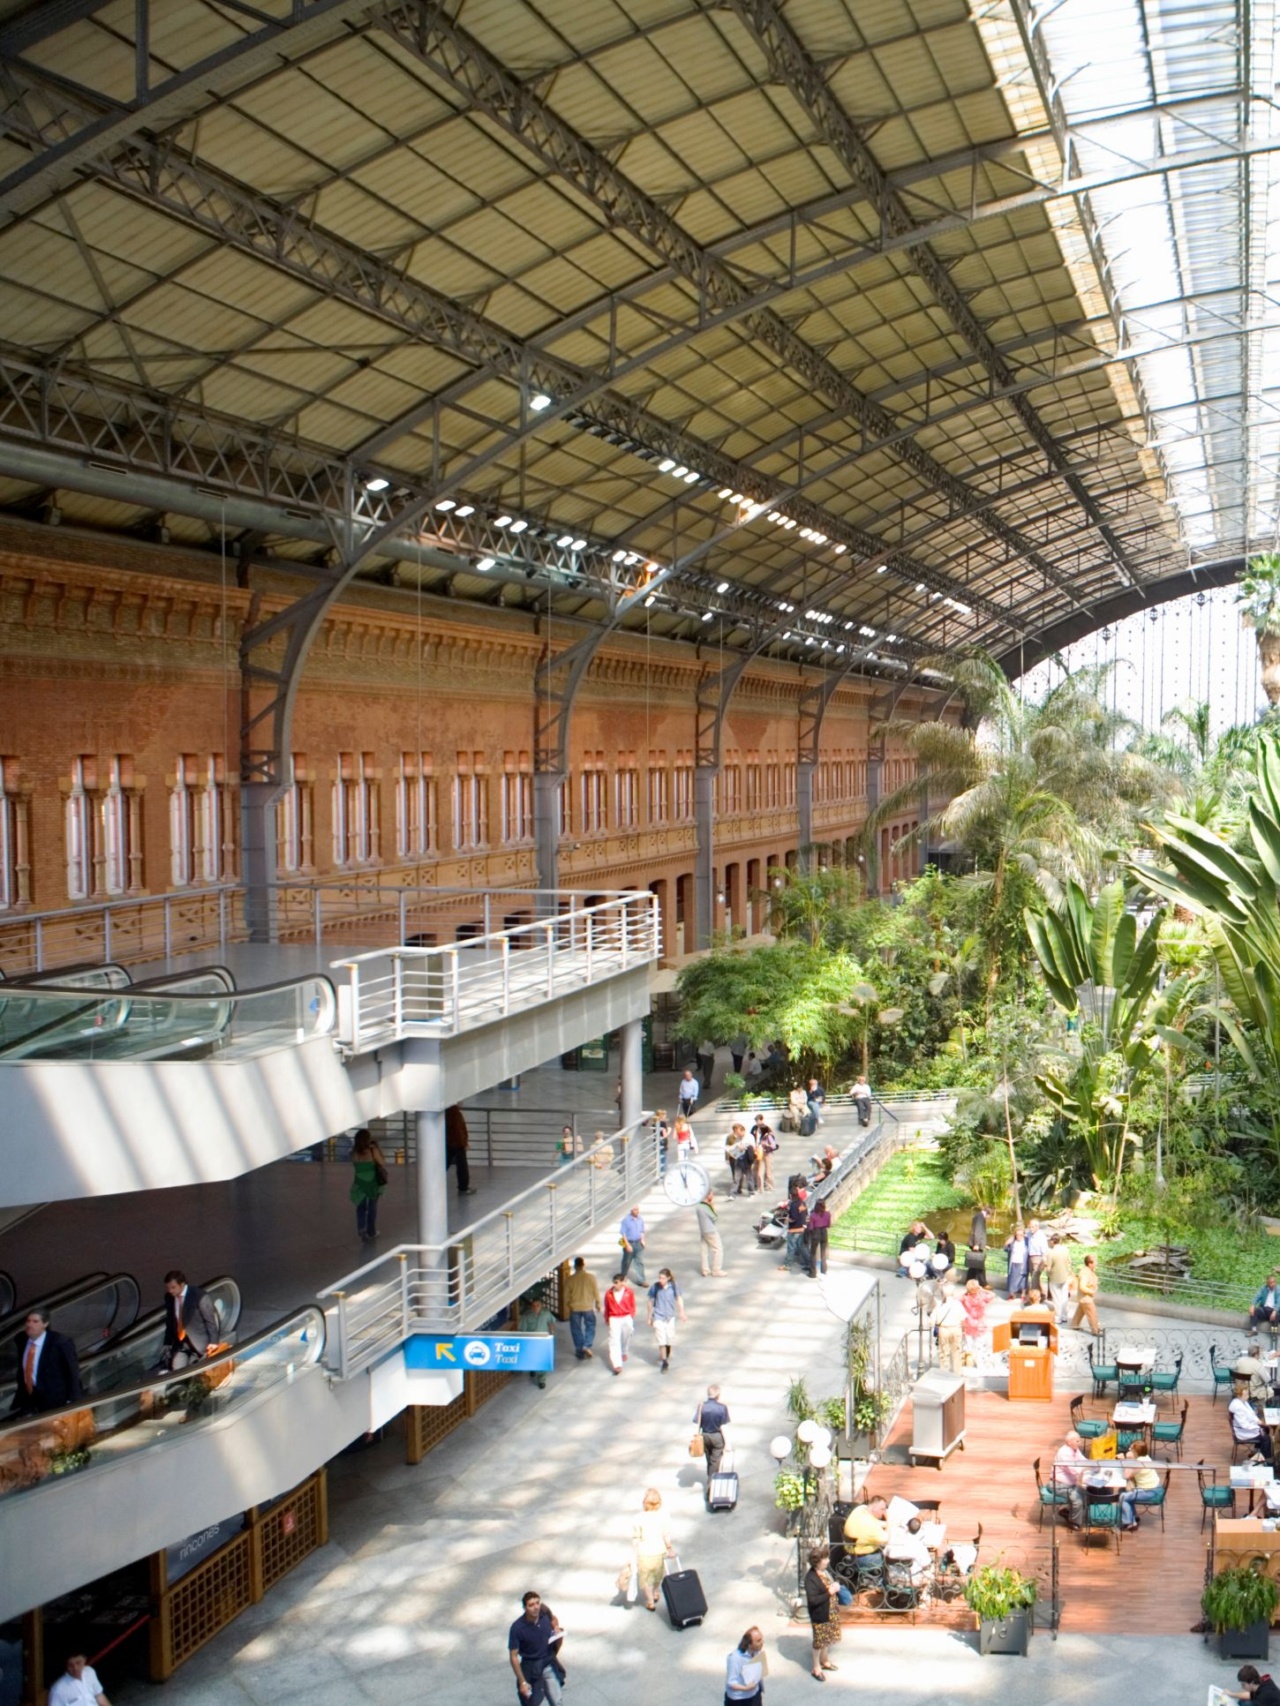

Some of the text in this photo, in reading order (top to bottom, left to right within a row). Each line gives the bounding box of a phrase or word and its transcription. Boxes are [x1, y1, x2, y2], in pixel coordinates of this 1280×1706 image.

[494, 1342, 520, 1353] Taxi
[494, 1354, 518, 1364] Taxi
[180, 1524, 220, 1560] rincones
